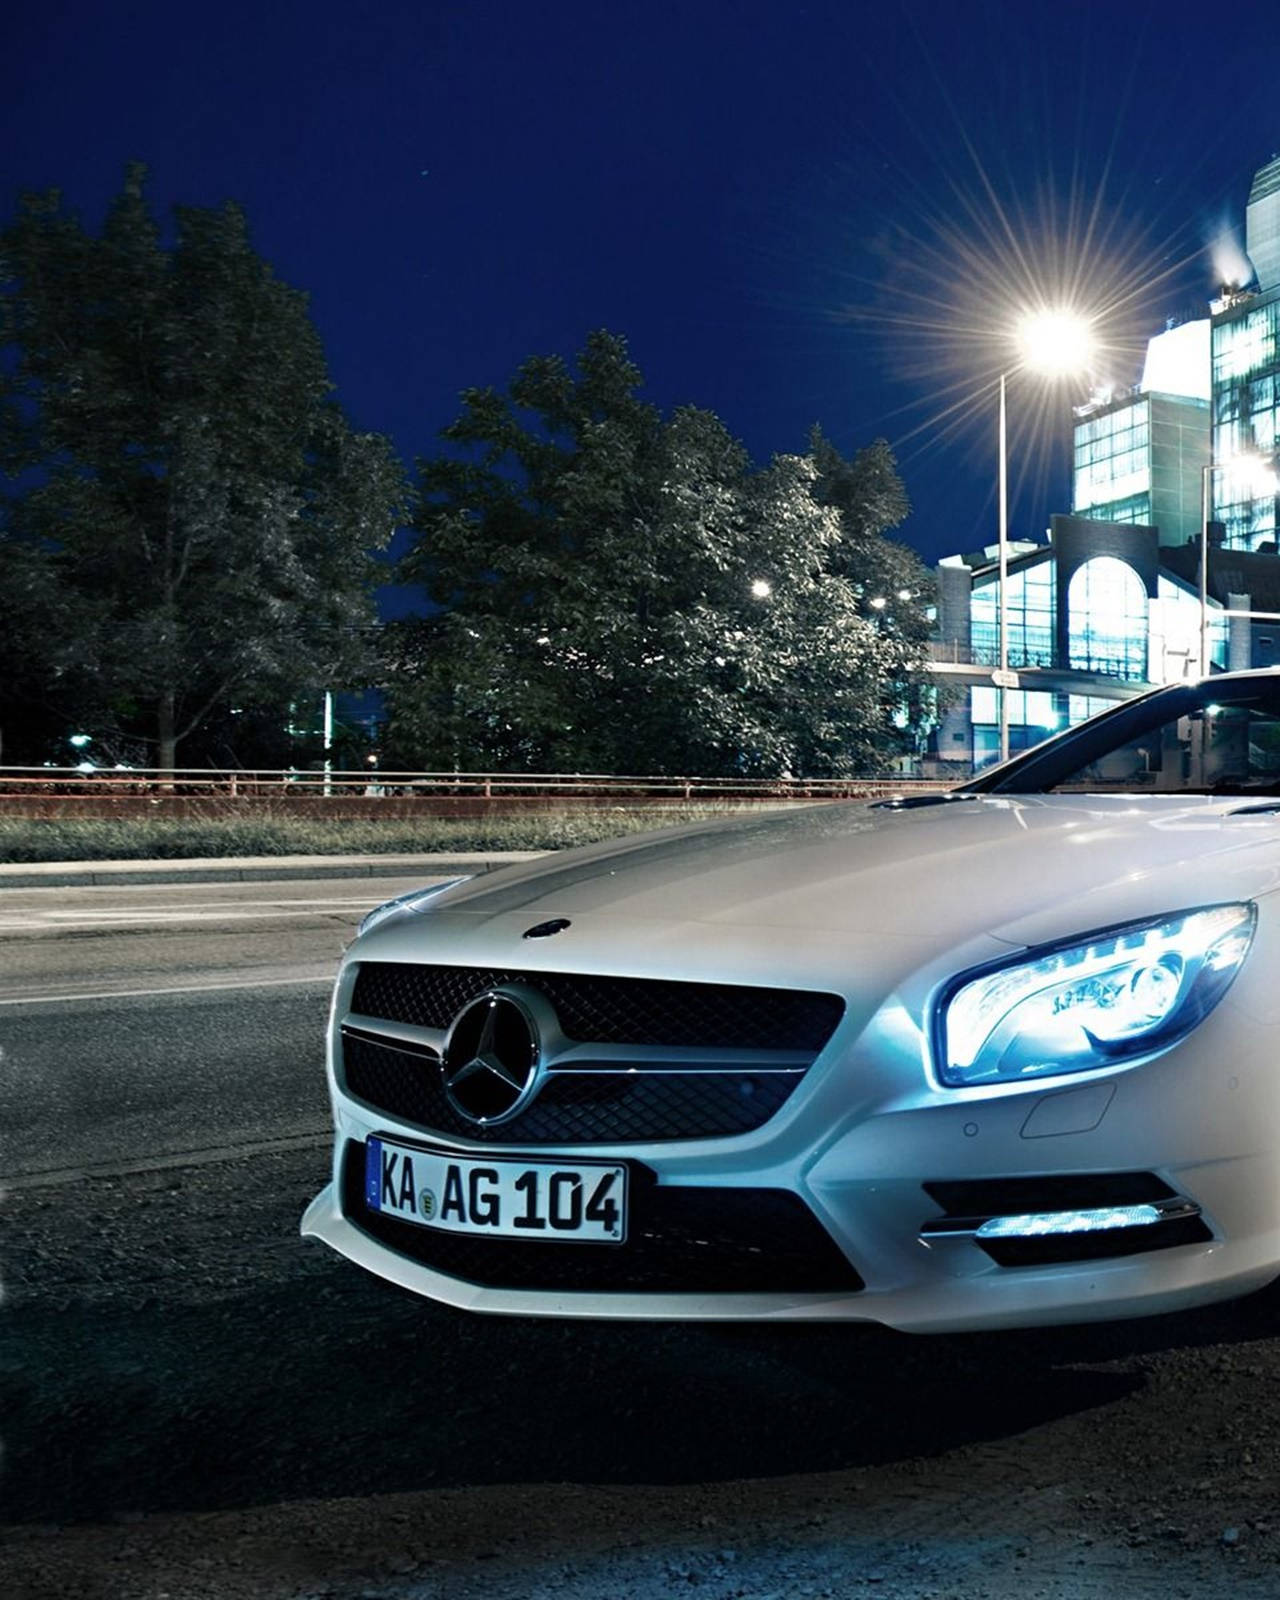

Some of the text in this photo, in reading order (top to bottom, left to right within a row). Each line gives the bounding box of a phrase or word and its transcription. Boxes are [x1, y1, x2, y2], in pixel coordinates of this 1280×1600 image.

[382, 1150, 619, 1232] KA AG 104
